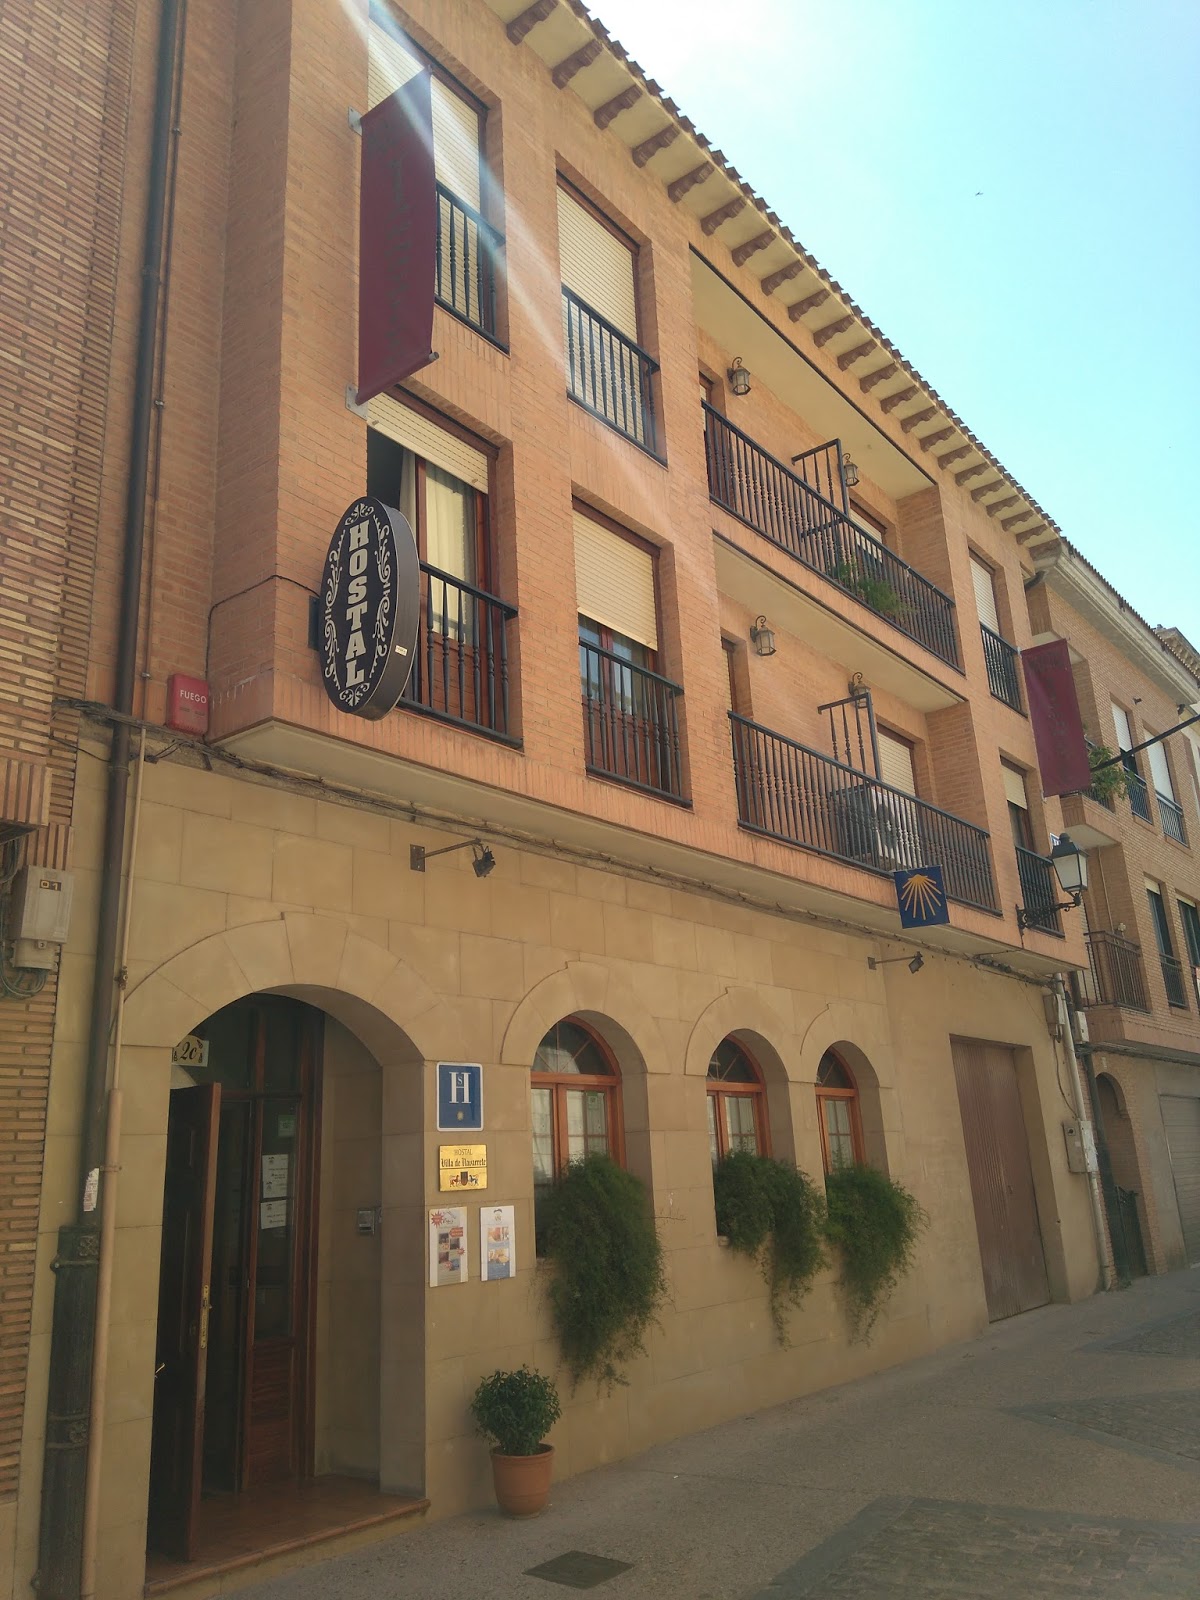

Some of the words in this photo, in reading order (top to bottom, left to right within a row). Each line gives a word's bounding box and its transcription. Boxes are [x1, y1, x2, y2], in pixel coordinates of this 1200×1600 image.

[345, 519, 370, 688] HOSTAL
[180, 689, 207, 704] FUEGO
[449, 1071, 472, 1104] H
[454, 1148, 473, 1156] HOSTAL
[454, 1158, 461, 1167] de
